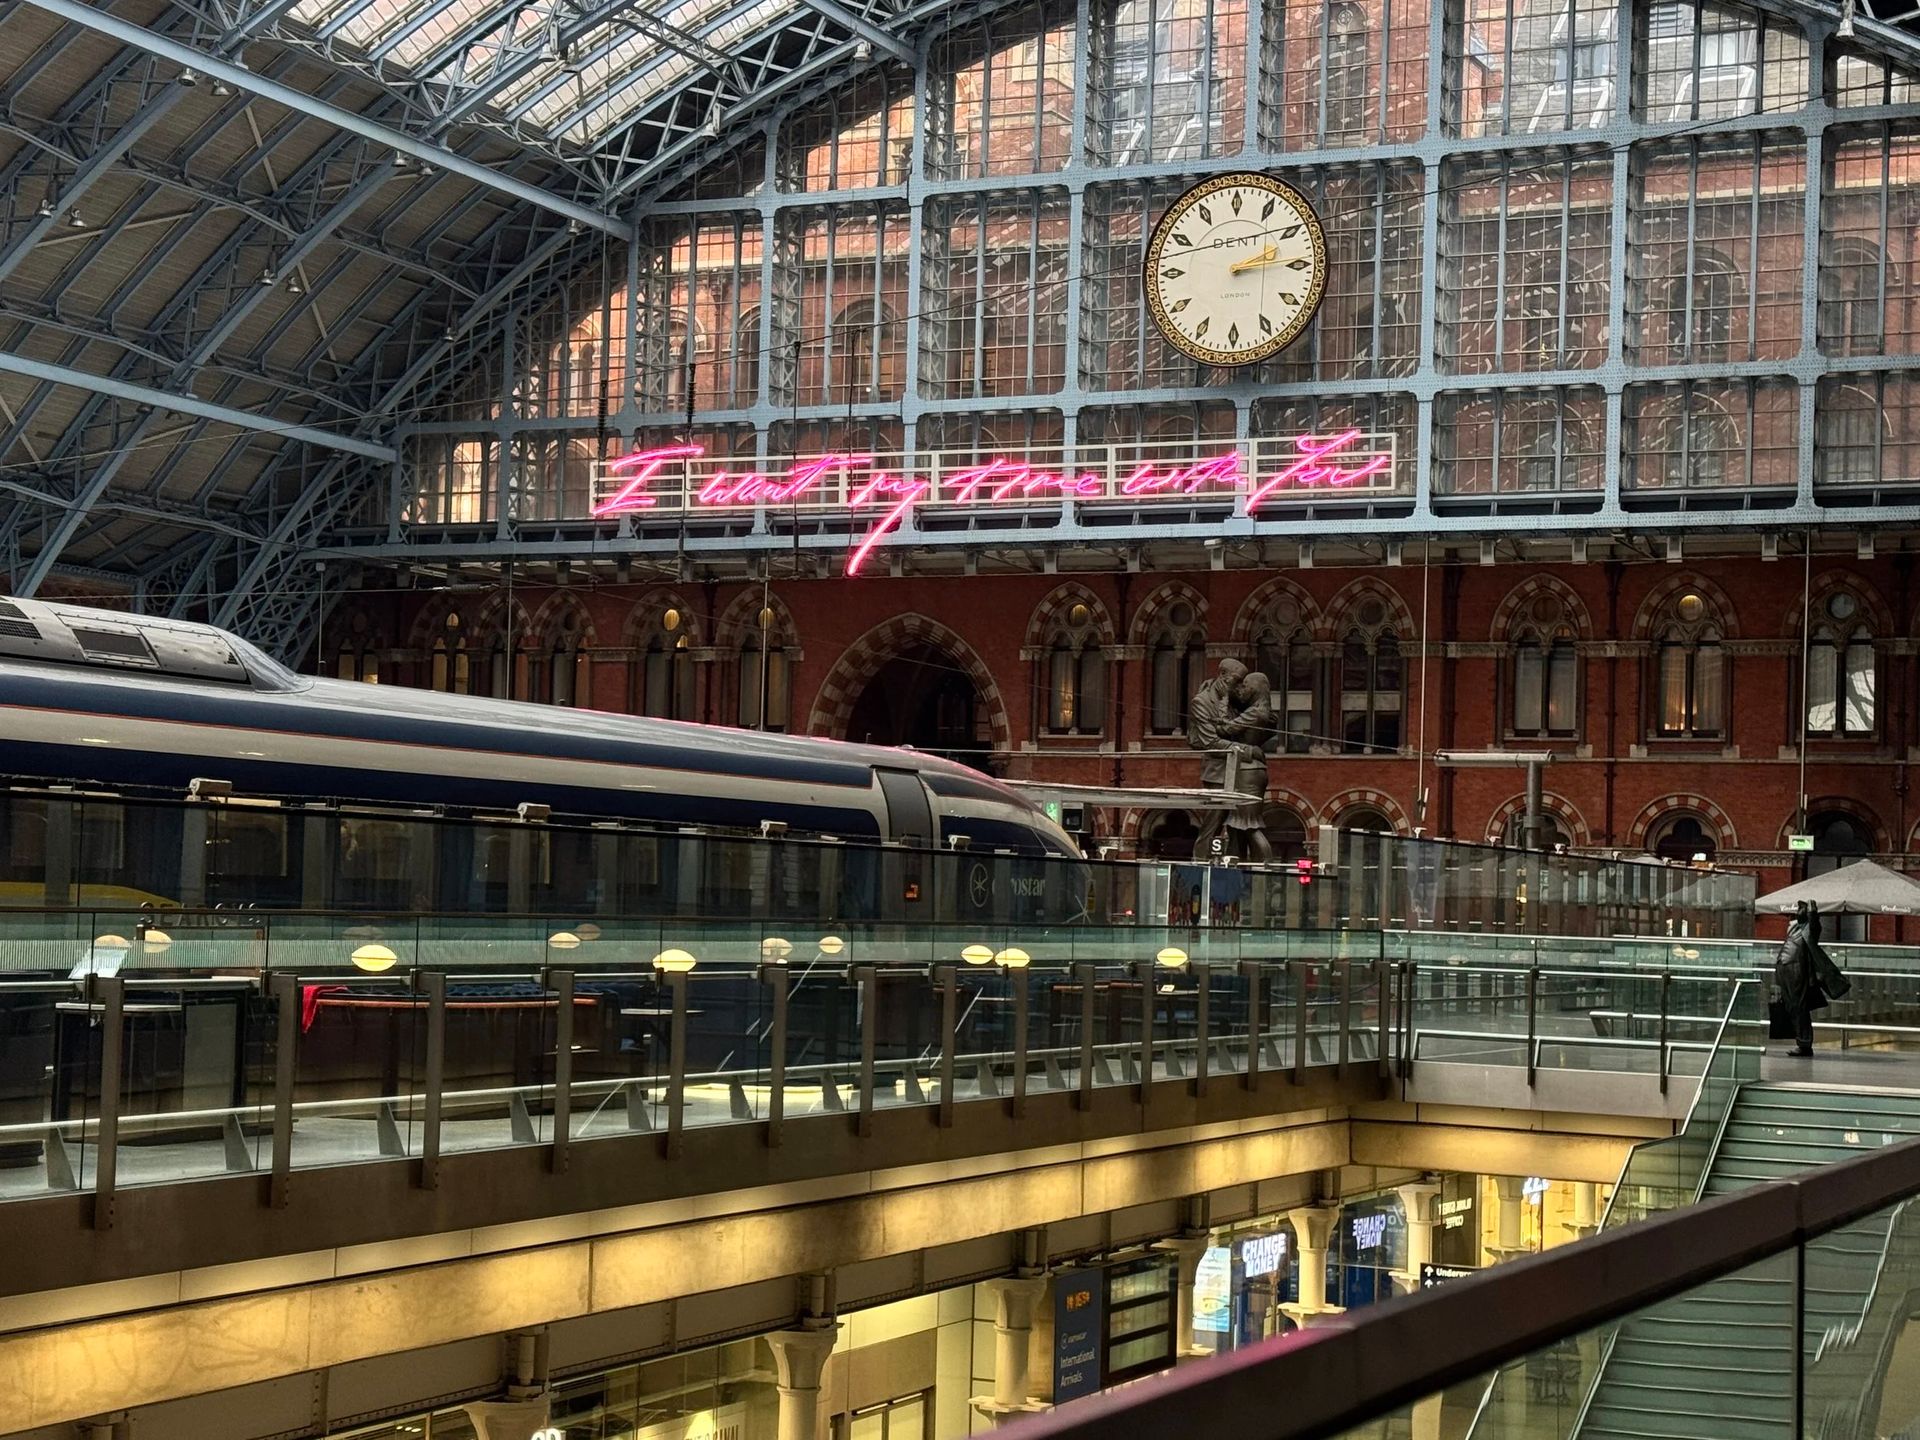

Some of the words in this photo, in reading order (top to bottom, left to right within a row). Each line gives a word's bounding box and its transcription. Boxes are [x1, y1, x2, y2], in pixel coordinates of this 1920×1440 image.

[1213, 236, 1258, 249] DENT
[592, 445, 704, 515] I
[1121, 450, 1250, 495] with
[1211, 839, 1222, 852] S
[1242, 1233, 1287, 1262] CHANGE
[1245, 1254, 1281, 1278] MONEY
[1060, 1347, 1095, 1369] International
[1060, 1370, 1083, 1388] Arrivals
